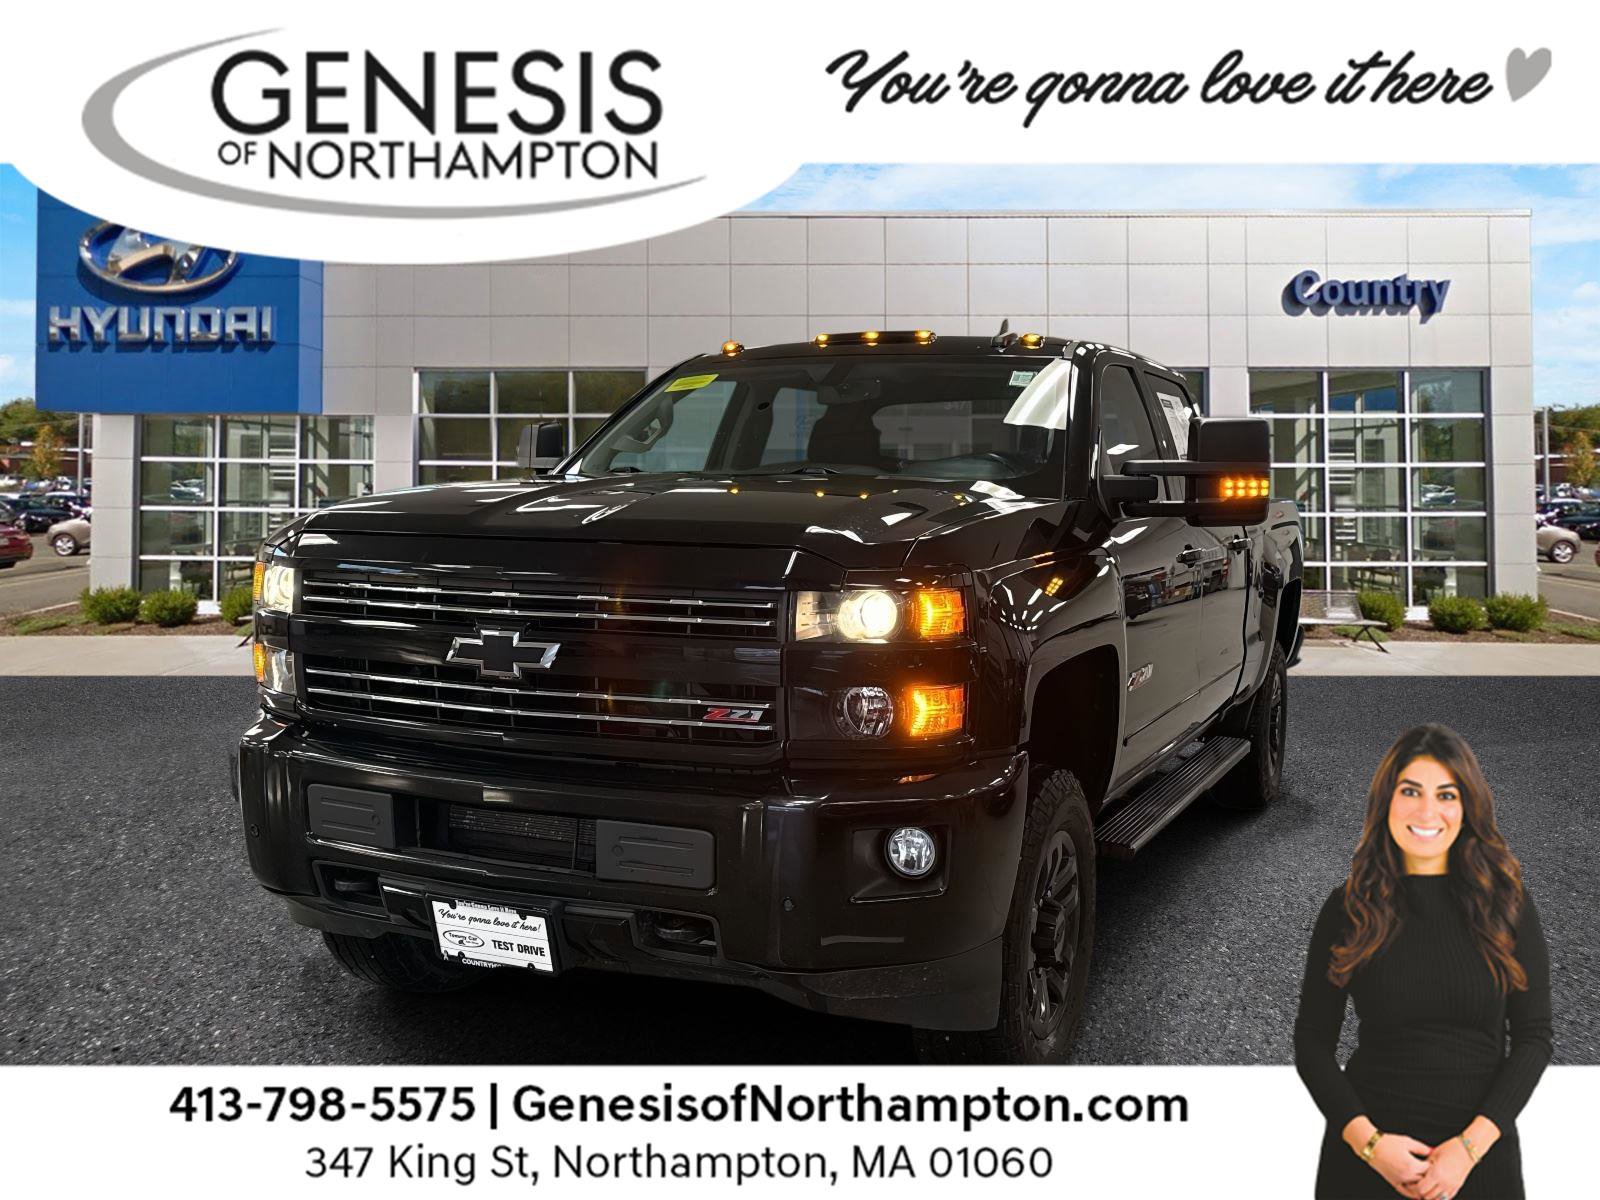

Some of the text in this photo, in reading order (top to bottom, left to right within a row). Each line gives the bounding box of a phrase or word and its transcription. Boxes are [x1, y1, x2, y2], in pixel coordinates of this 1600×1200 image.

[1283, 269, 1451, 324] Country
[48, 306, 272, 342] HYUNDAI
[438, 908, 466, 921] You're
[468, 916, 492, 925] gonna
[493, 916, 510, 927] love
[491, 939, 546, 957] TEST DRIVE
